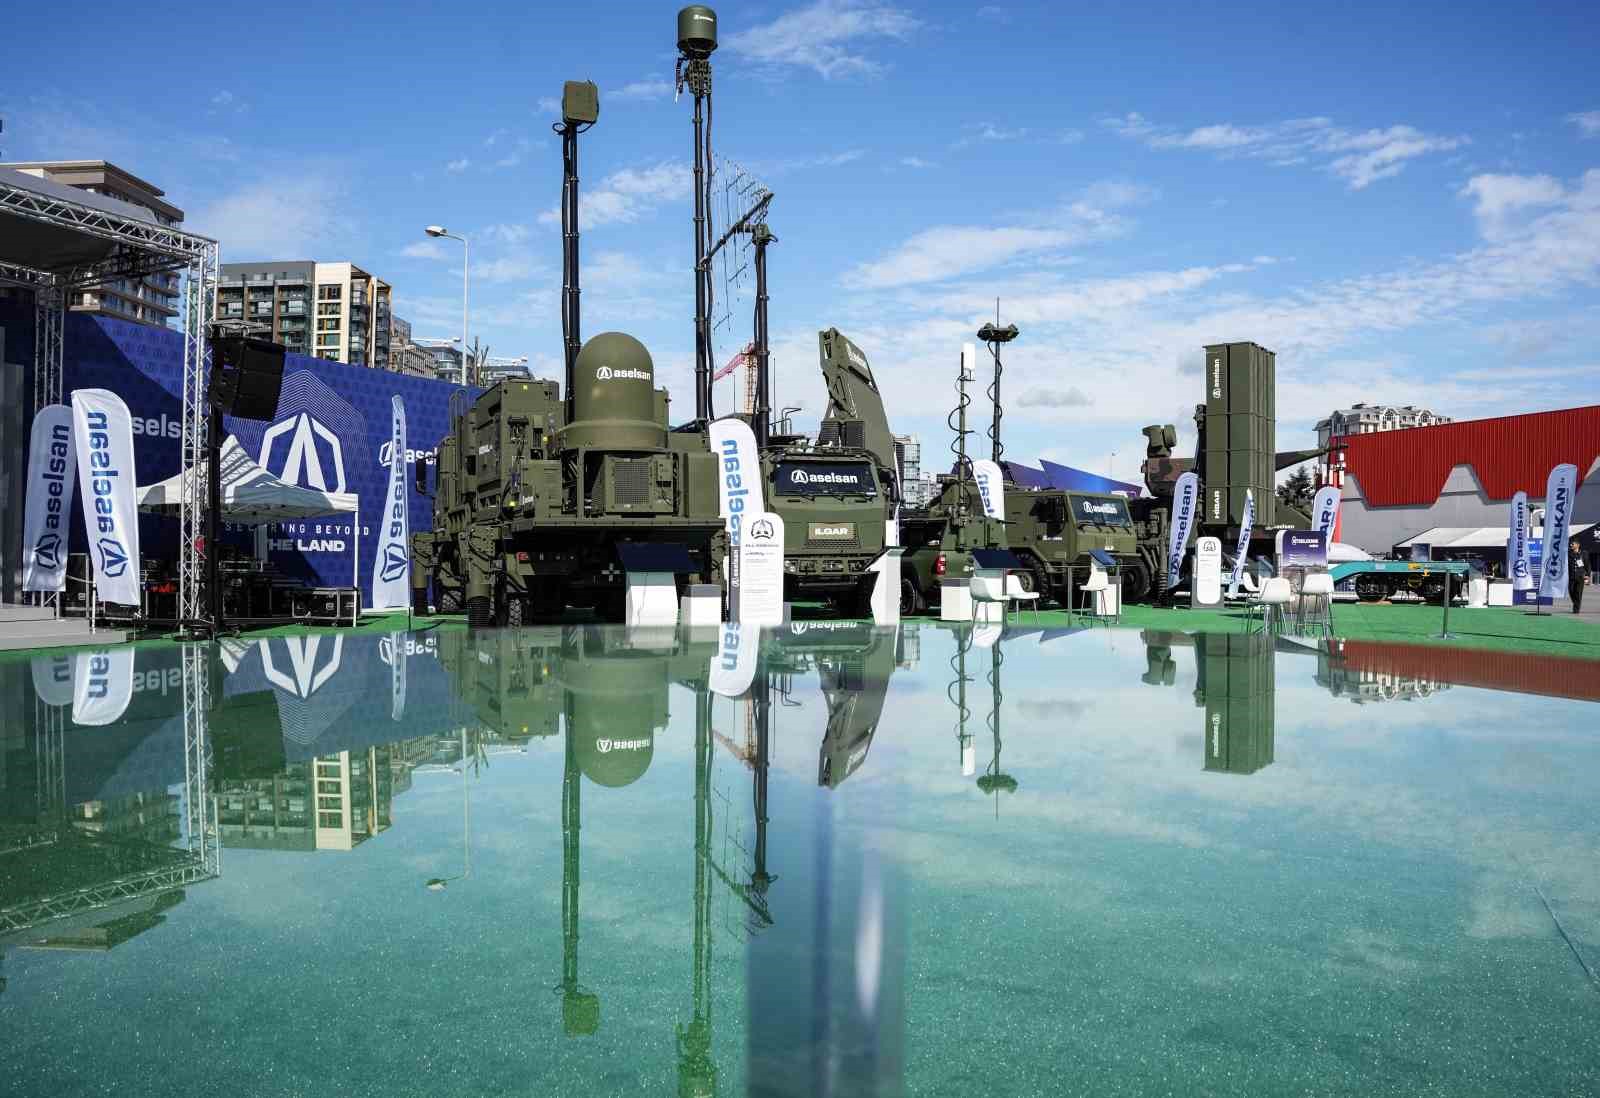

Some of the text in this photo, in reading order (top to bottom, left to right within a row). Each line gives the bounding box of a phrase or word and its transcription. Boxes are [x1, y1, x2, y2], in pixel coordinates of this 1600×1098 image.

[613, 367, 651, 381] aselsan
[131, 413, 182, 438] sels
[42, 424, 70, 529] aselsan
[809, 472, 858, 484] aselsan
[1175, 484, 1193, 550] aselsan
[1515, 502, 1525, 557] aselsan
[1551, 487, 1566, 567] KALKAN
[297, 538, 346, 552] LAND
